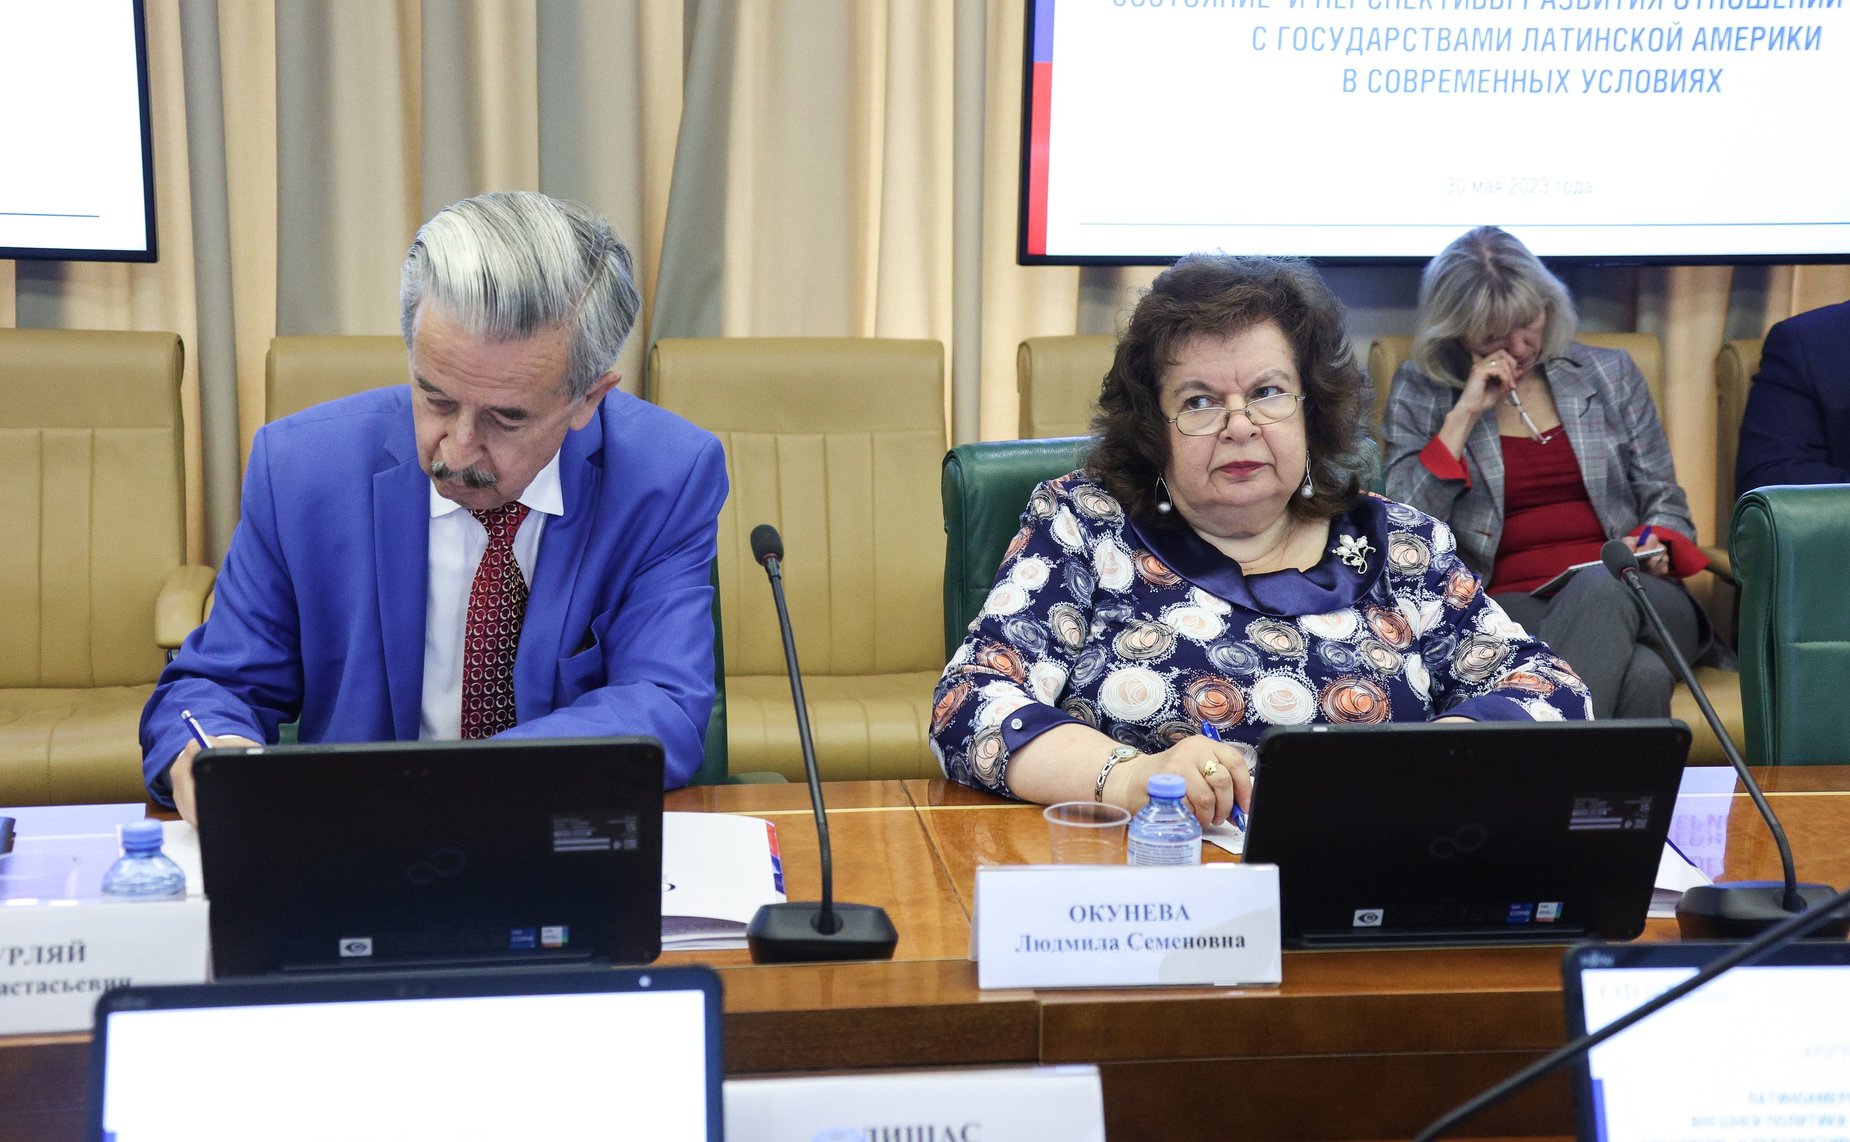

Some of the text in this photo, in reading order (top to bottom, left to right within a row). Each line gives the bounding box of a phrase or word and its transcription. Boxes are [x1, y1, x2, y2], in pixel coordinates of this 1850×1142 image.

[1252, 21, 1823, 55] С ГОСУДАРСТВАМИ ЛАТИНСКОЙ АМЕРИКИ
[1342, 68, 1724, 94] В СОВРЕМЕННЫХ УСЛОВИЯХ
[1068, 903, 1191, 923] ОКУНЕВА
[1015, 932, 1246, 953] Людмила Семеновна
